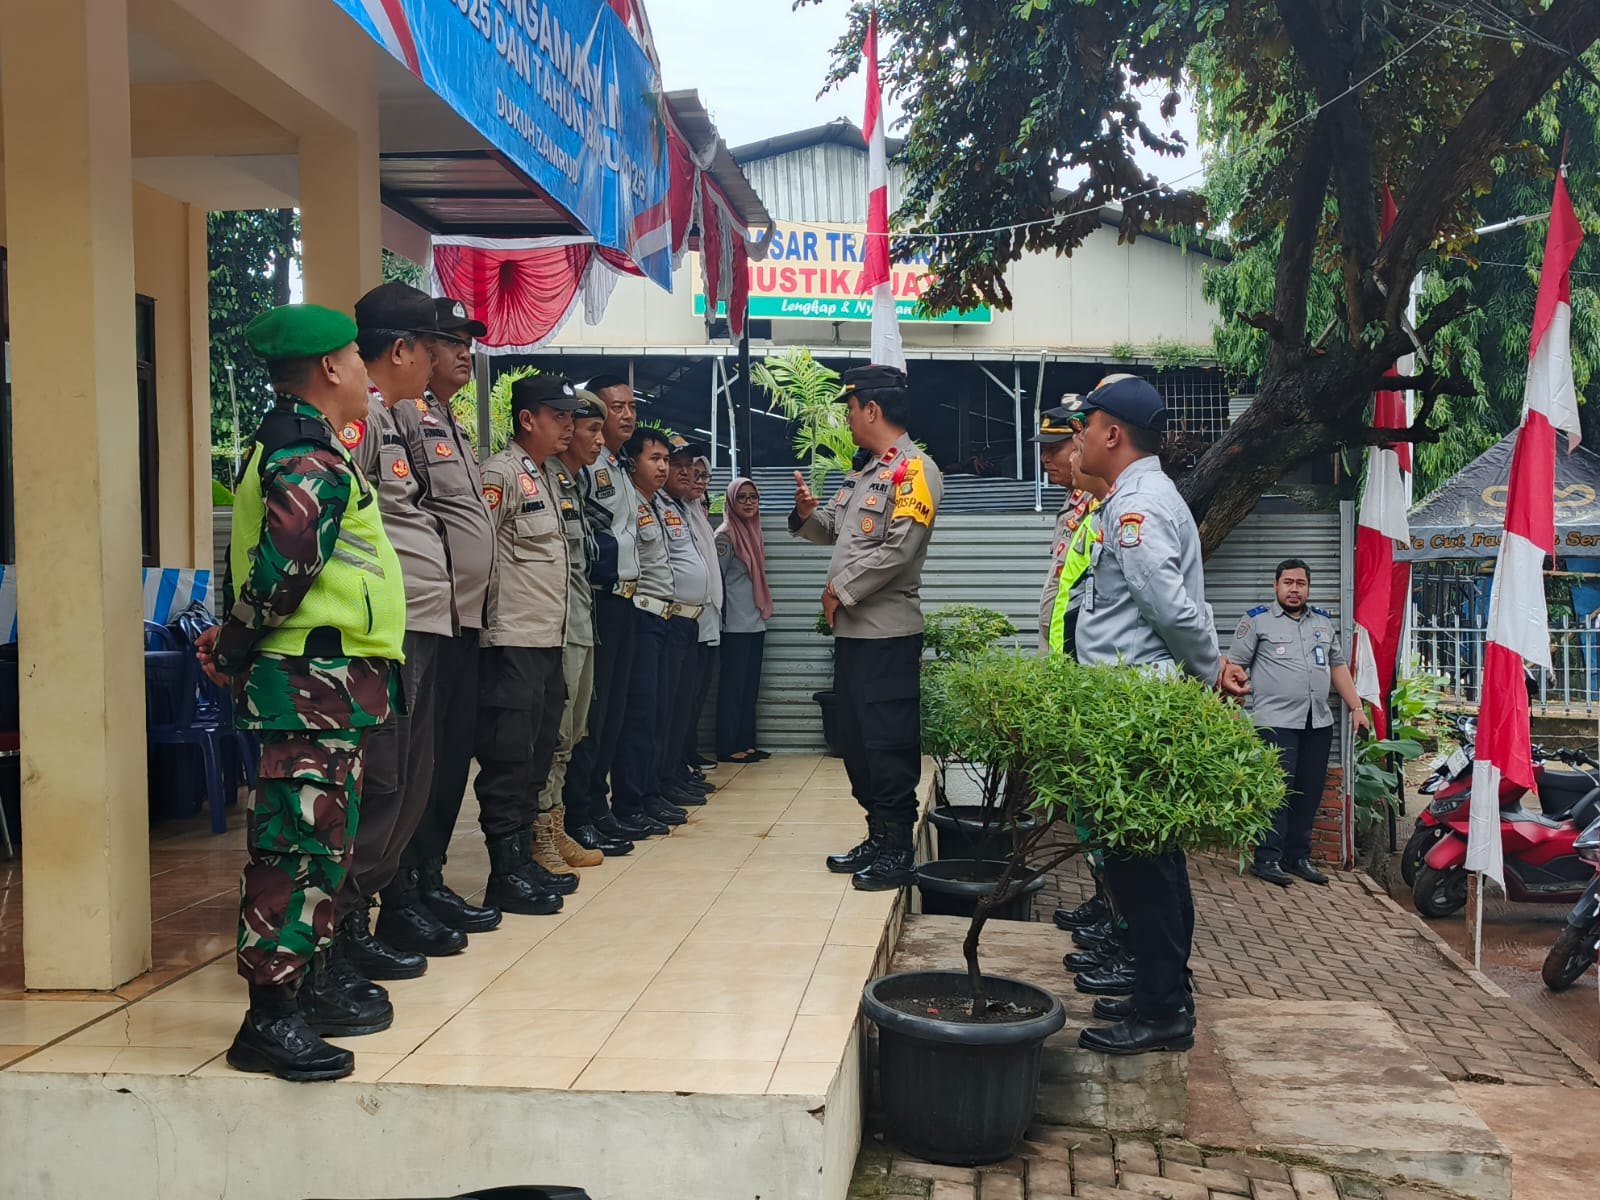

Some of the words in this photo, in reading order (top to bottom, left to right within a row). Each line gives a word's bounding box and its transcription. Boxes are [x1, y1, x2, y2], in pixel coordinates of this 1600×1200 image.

[494, 7, 532, 86] DAN
[532, 54, 585, 140] TAHUN
[496, 86, 536, 147] DUKUH
[537, 126, 578, 185] ZAMRUD
[781, 299, 837, 316] Lengkap
[840, 300, 850, 314] &
[1430, 533, 1466, 549] Cut
